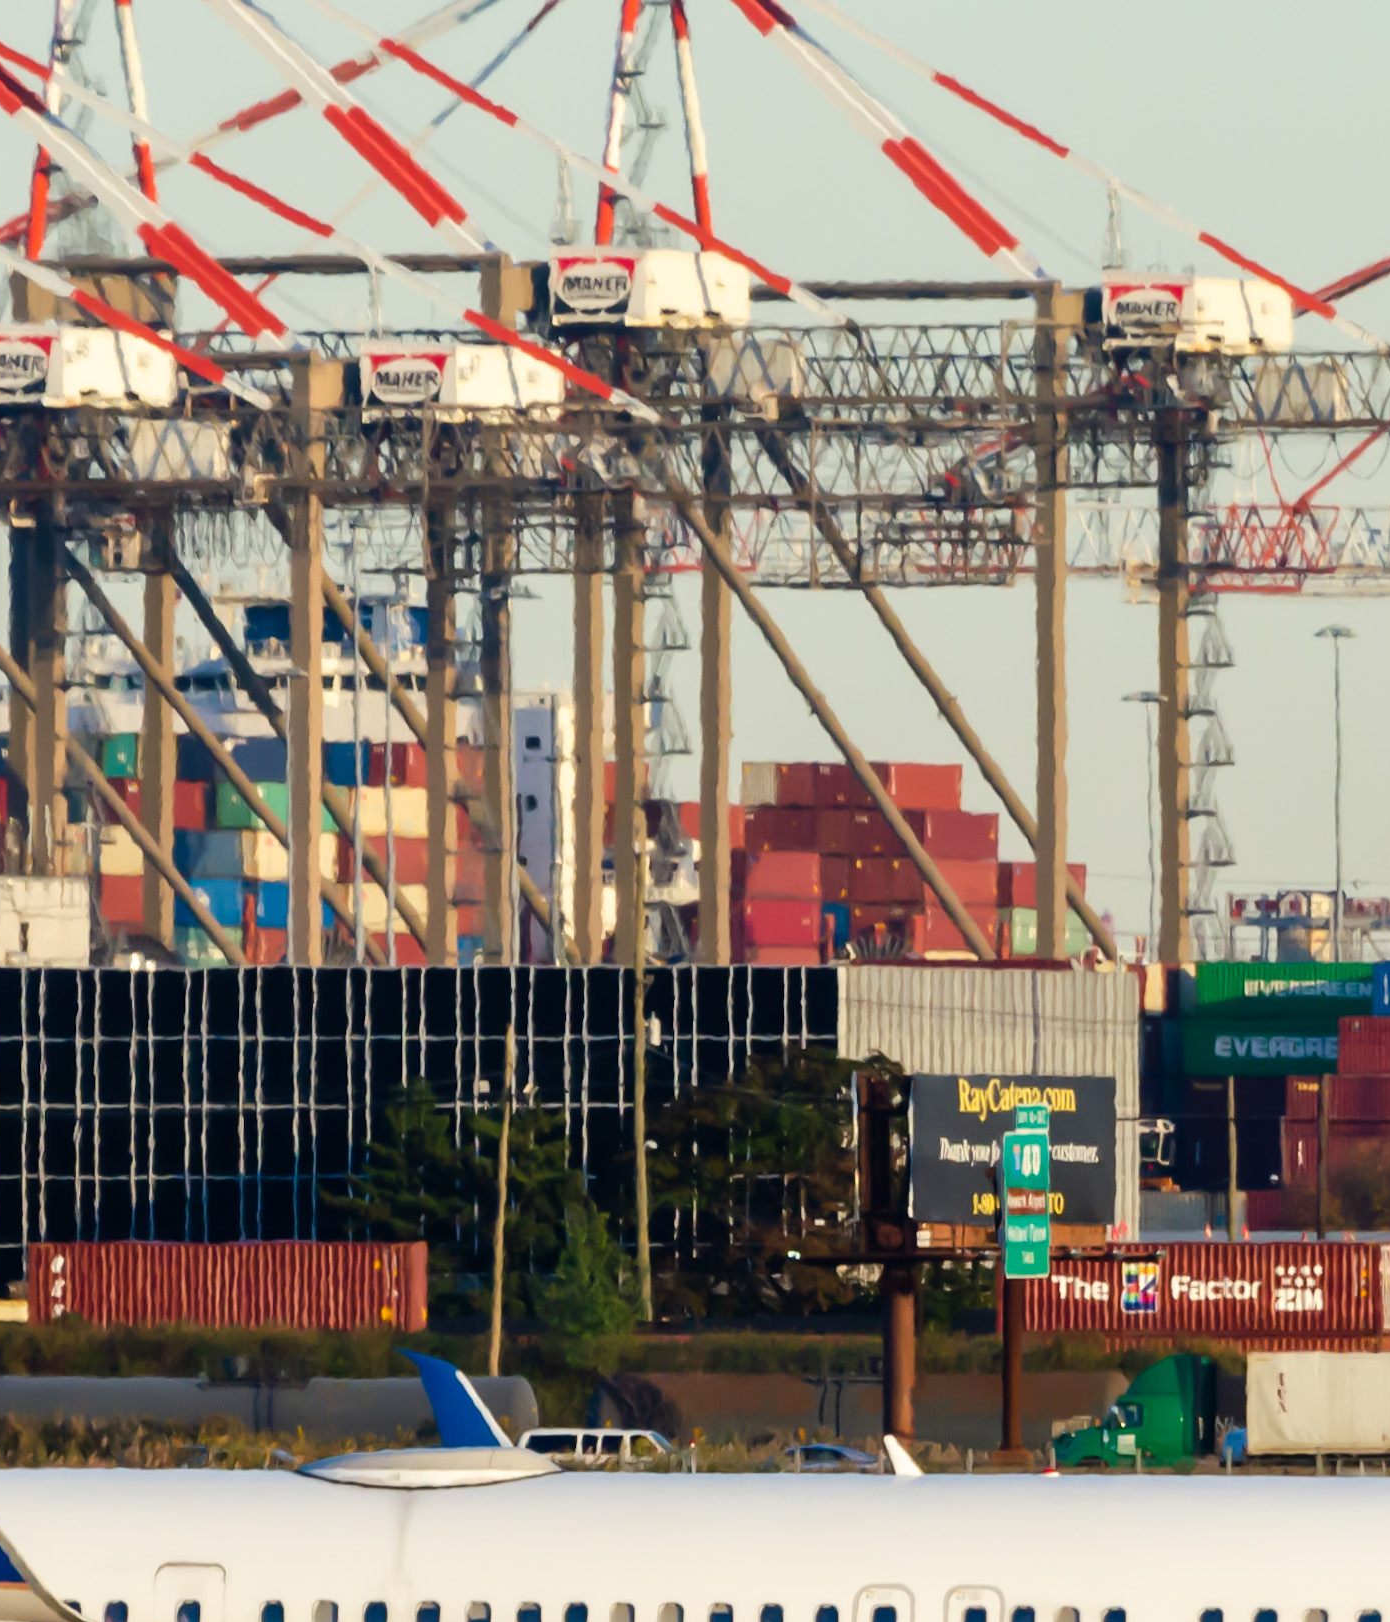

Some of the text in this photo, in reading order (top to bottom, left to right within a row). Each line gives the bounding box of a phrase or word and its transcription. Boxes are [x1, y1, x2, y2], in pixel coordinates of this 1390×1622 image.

[1243, 979, 1372, 998] EVERGREEN
[1215, 1036, 1338, 1057] EVERGRE
[1051, 1274, 1109, 1300] The
[1171, 1275, 1262, 1301] Factor
